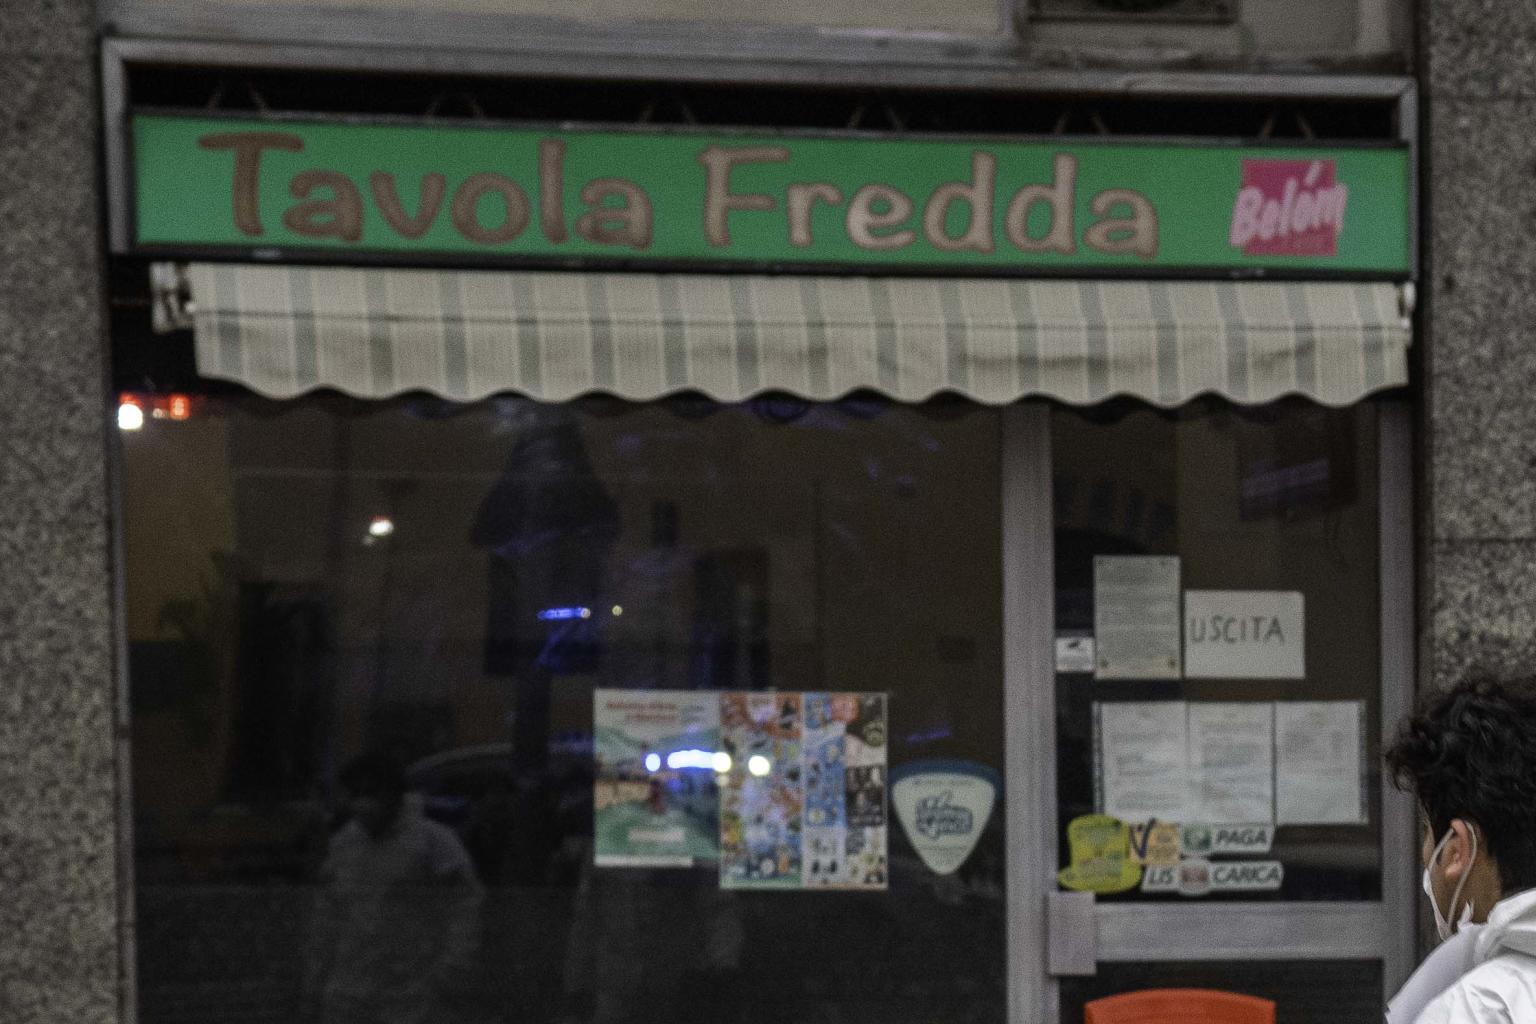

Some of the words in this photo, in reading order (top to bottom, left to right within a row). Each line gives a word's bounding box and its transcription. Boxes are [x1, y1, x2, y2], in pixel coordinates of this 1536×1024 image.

[199, 132, 654, 249] Tavola
[698, 143, 1160, 258] Fredda
[1190, 614, 1285, 645] USCITA
[1215, 830, 1269, 847] PAGA
[1212, 866, 1280, 884] CARICA
